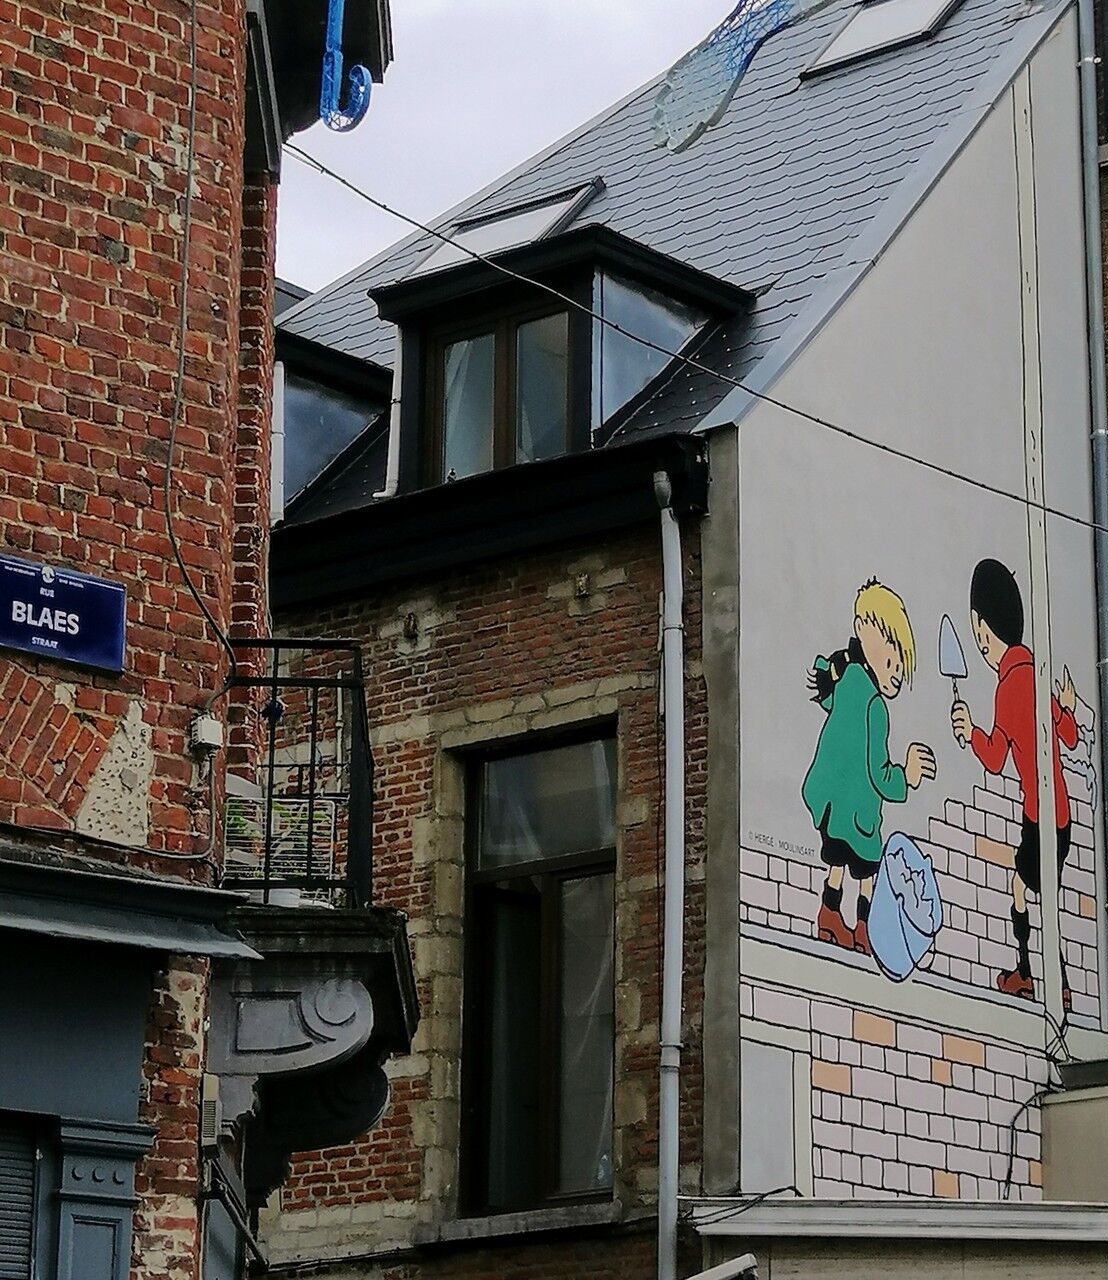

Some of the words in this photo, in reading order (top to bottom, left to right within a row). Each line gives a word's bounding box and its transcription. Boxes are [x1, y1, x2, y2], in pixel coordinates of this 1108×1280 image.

[40, 587, 54, 598] RUE
[12, 600, 79, 635] BLAES
[31, 636, 58, 649] STRAAT
